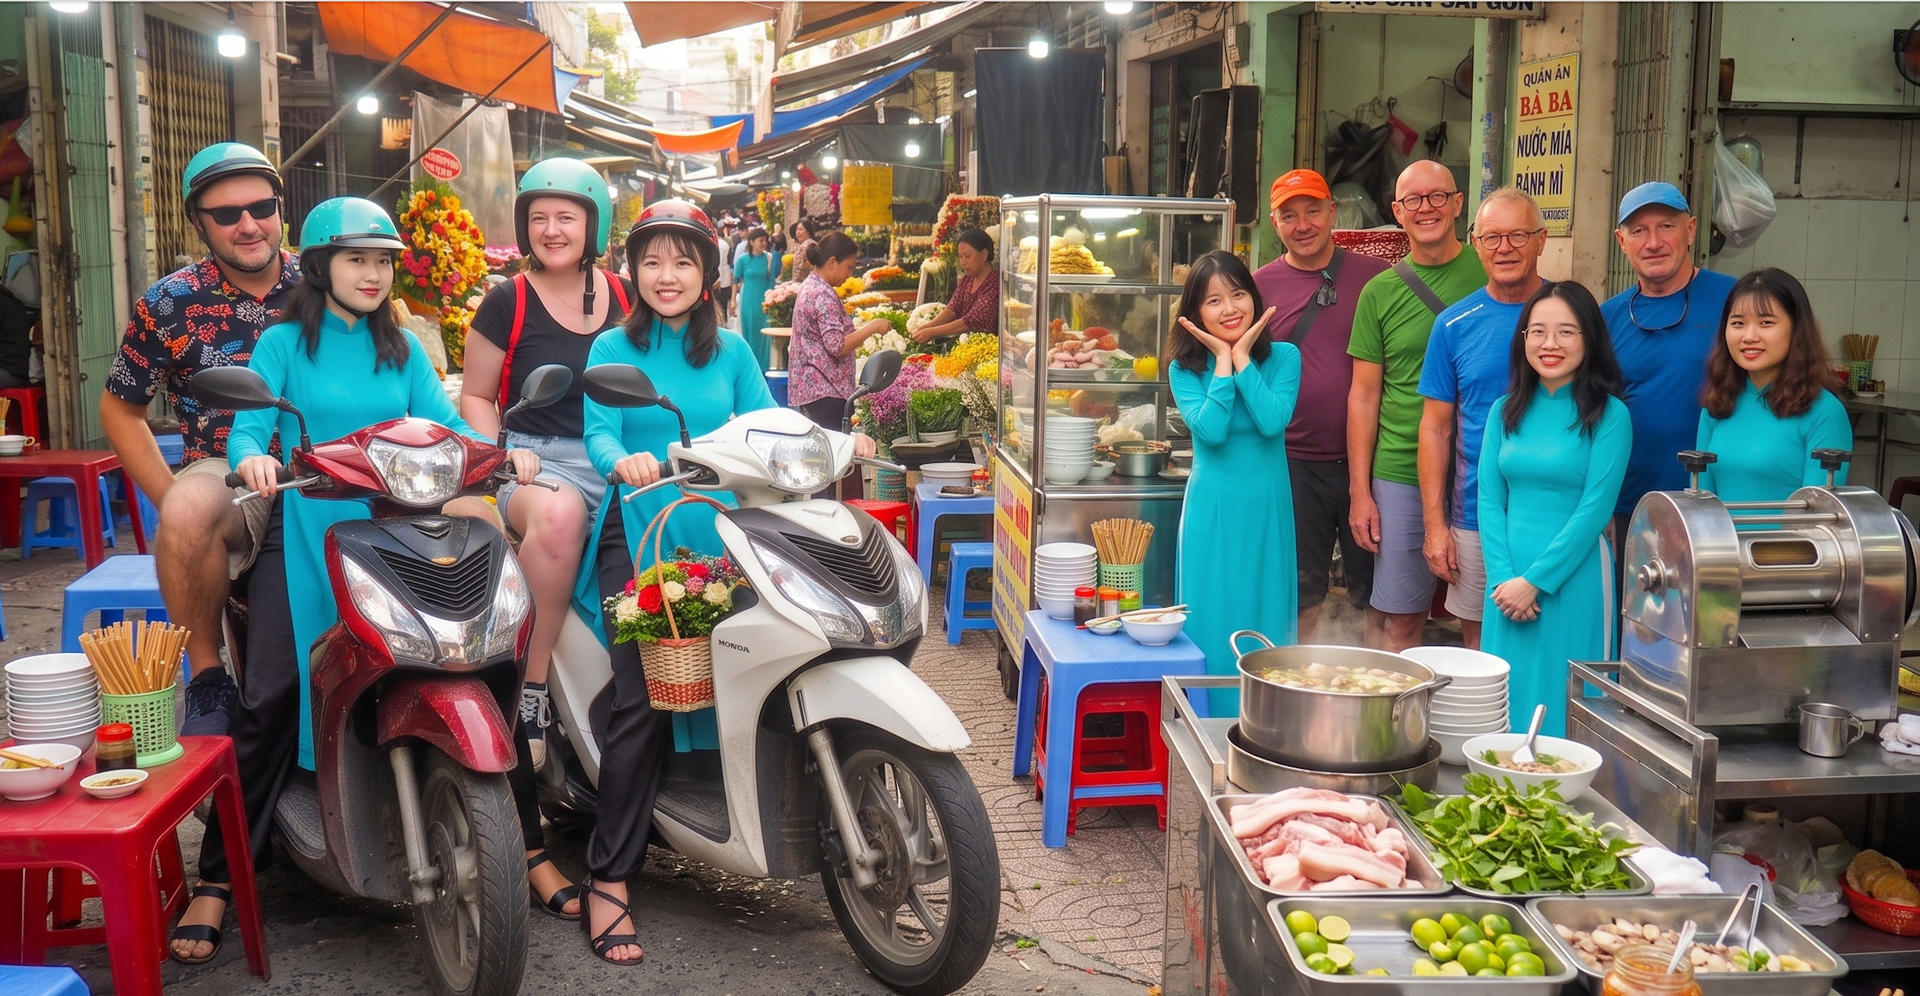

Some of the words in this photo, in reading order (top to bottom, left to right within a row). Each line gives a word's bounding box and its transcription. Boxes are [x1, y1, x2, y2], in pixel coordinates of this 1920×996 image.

[1523, 67, 1552, 87] QUÁN
[1520, 89, 1543, 117] BÀ
[1548, 89, 1572, 113] BA
[1517, 125, 1547, 158] NƯỚC
[1550, 122, 1572, 156] MÍA
[1549, 163, 1564, 195] MÌ
[718, 639, 750, 654] HONDA
